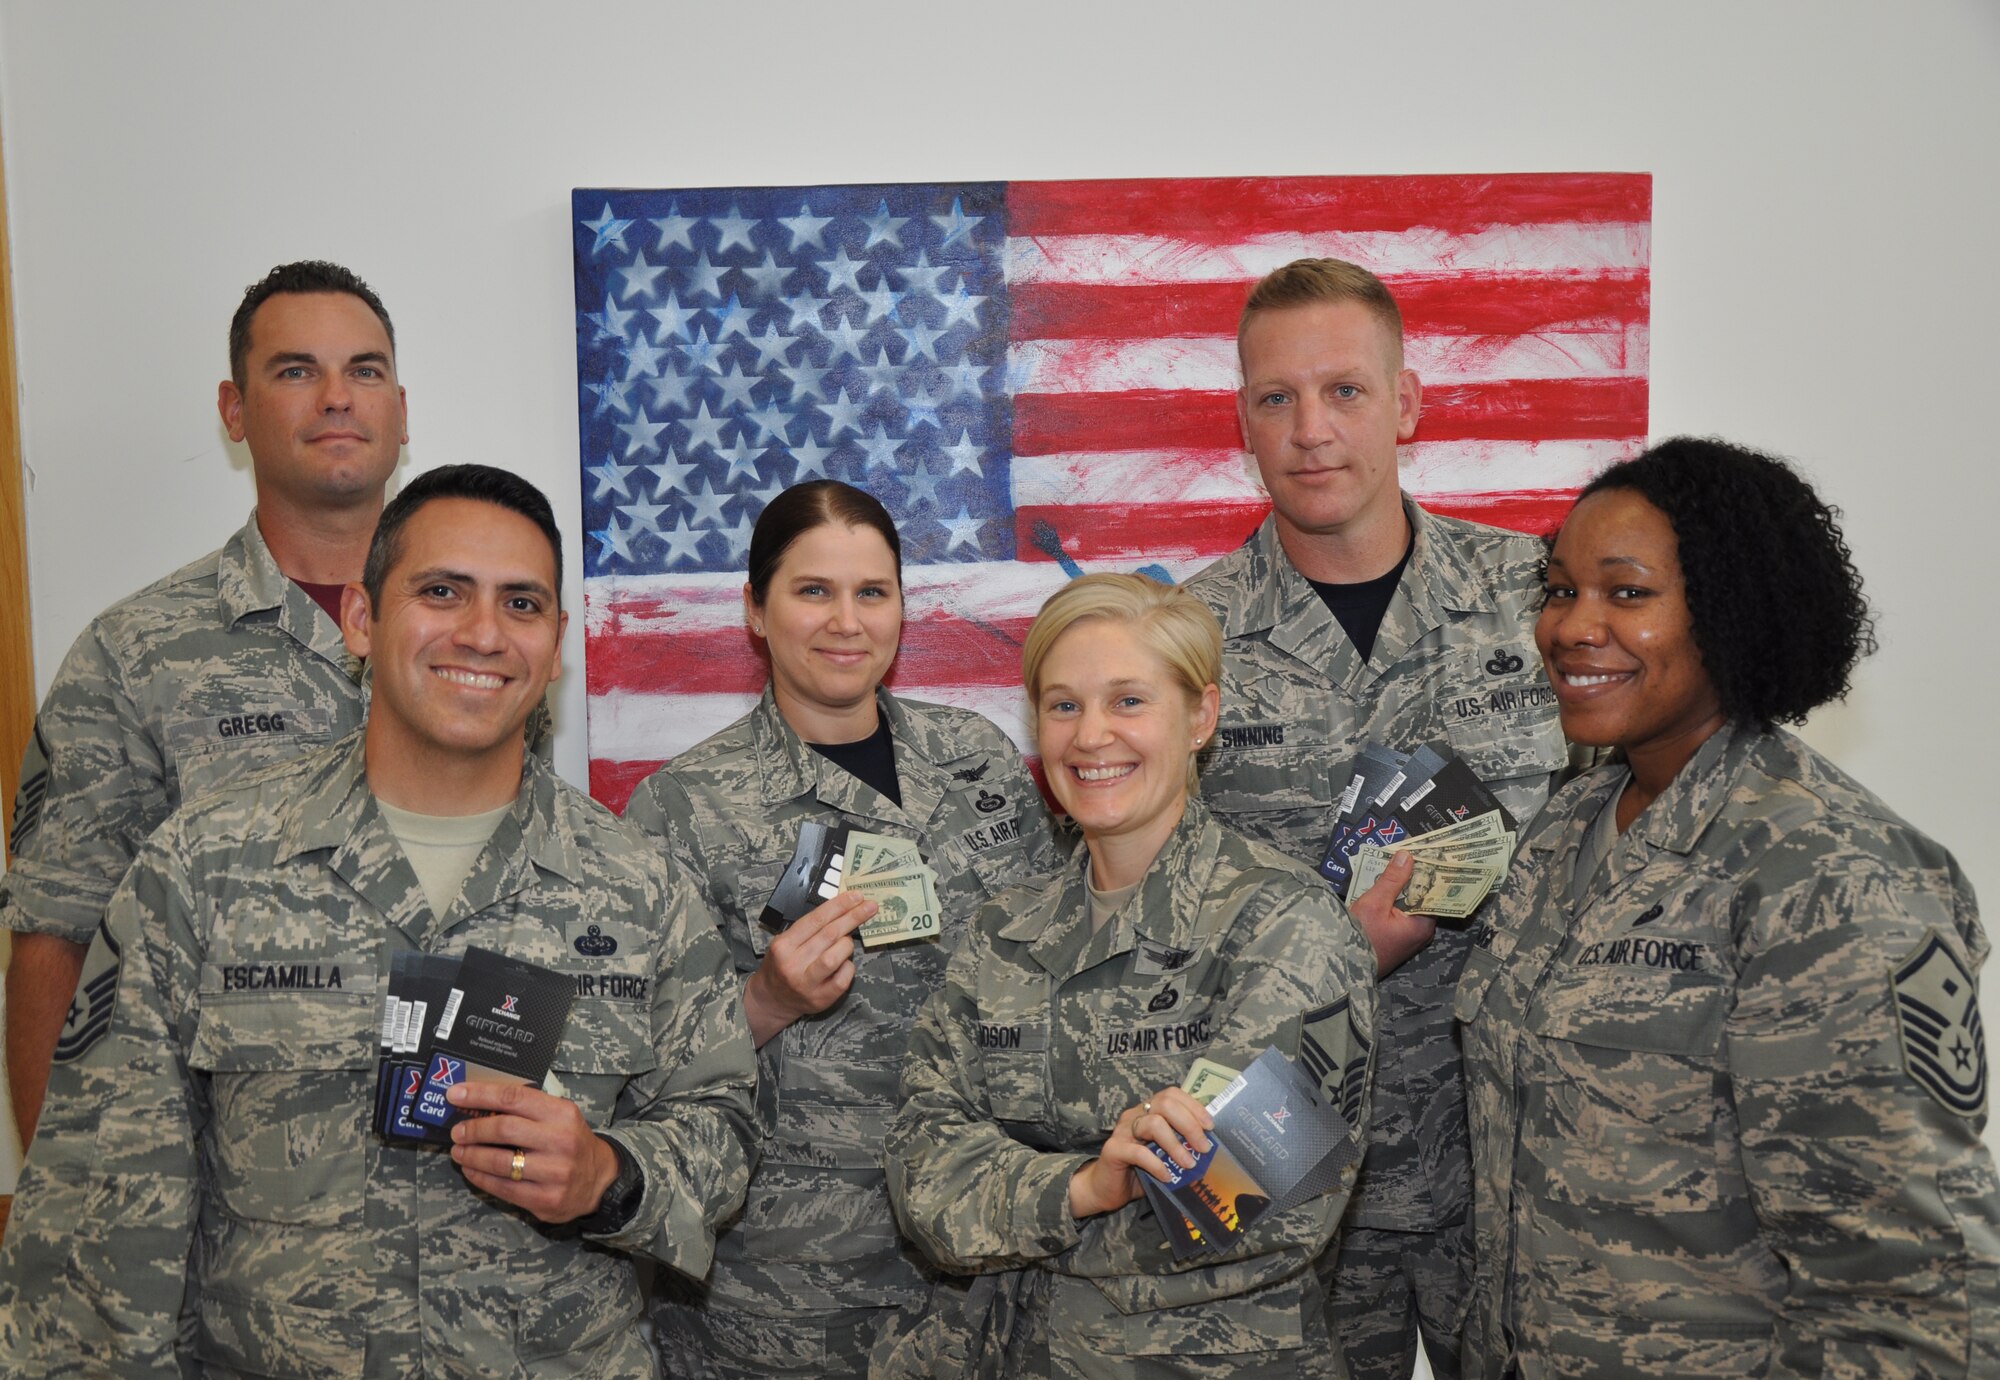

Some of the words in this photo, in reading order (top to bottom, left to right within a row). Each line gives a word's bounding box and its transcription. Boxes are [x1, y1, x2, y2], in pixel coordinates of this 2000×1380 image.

[1456, 697, 1485, 718] U.S.
[1491, 690, 1517, 713] AIR
[218, 713, 285, 738] GREGG
[1221, 725, 1284, 748] SINNING
[963, 830, 993, 852] U.S.
[990, 821, 1013, 844] AIR
[911, 913, 933, 931] 20
[1602, 938, 1631, 965] AIR
[1632, 938, 1704, 971] FORCE
[223, 965, 342, 990] ESCAMILLA
[600, 975, 648, 1000] FORCE
[491, 1007, 521, 1021] EXCHANGE
[465, 1014, 535, 1043] GIFTCARD
[1132, 1028, 1158, 1052] AIR
[1163, 1017, 1212, 1050] FORC
[419, 1102, 447, 1118] Card
[423, 1091, 446, 1106] Gift
